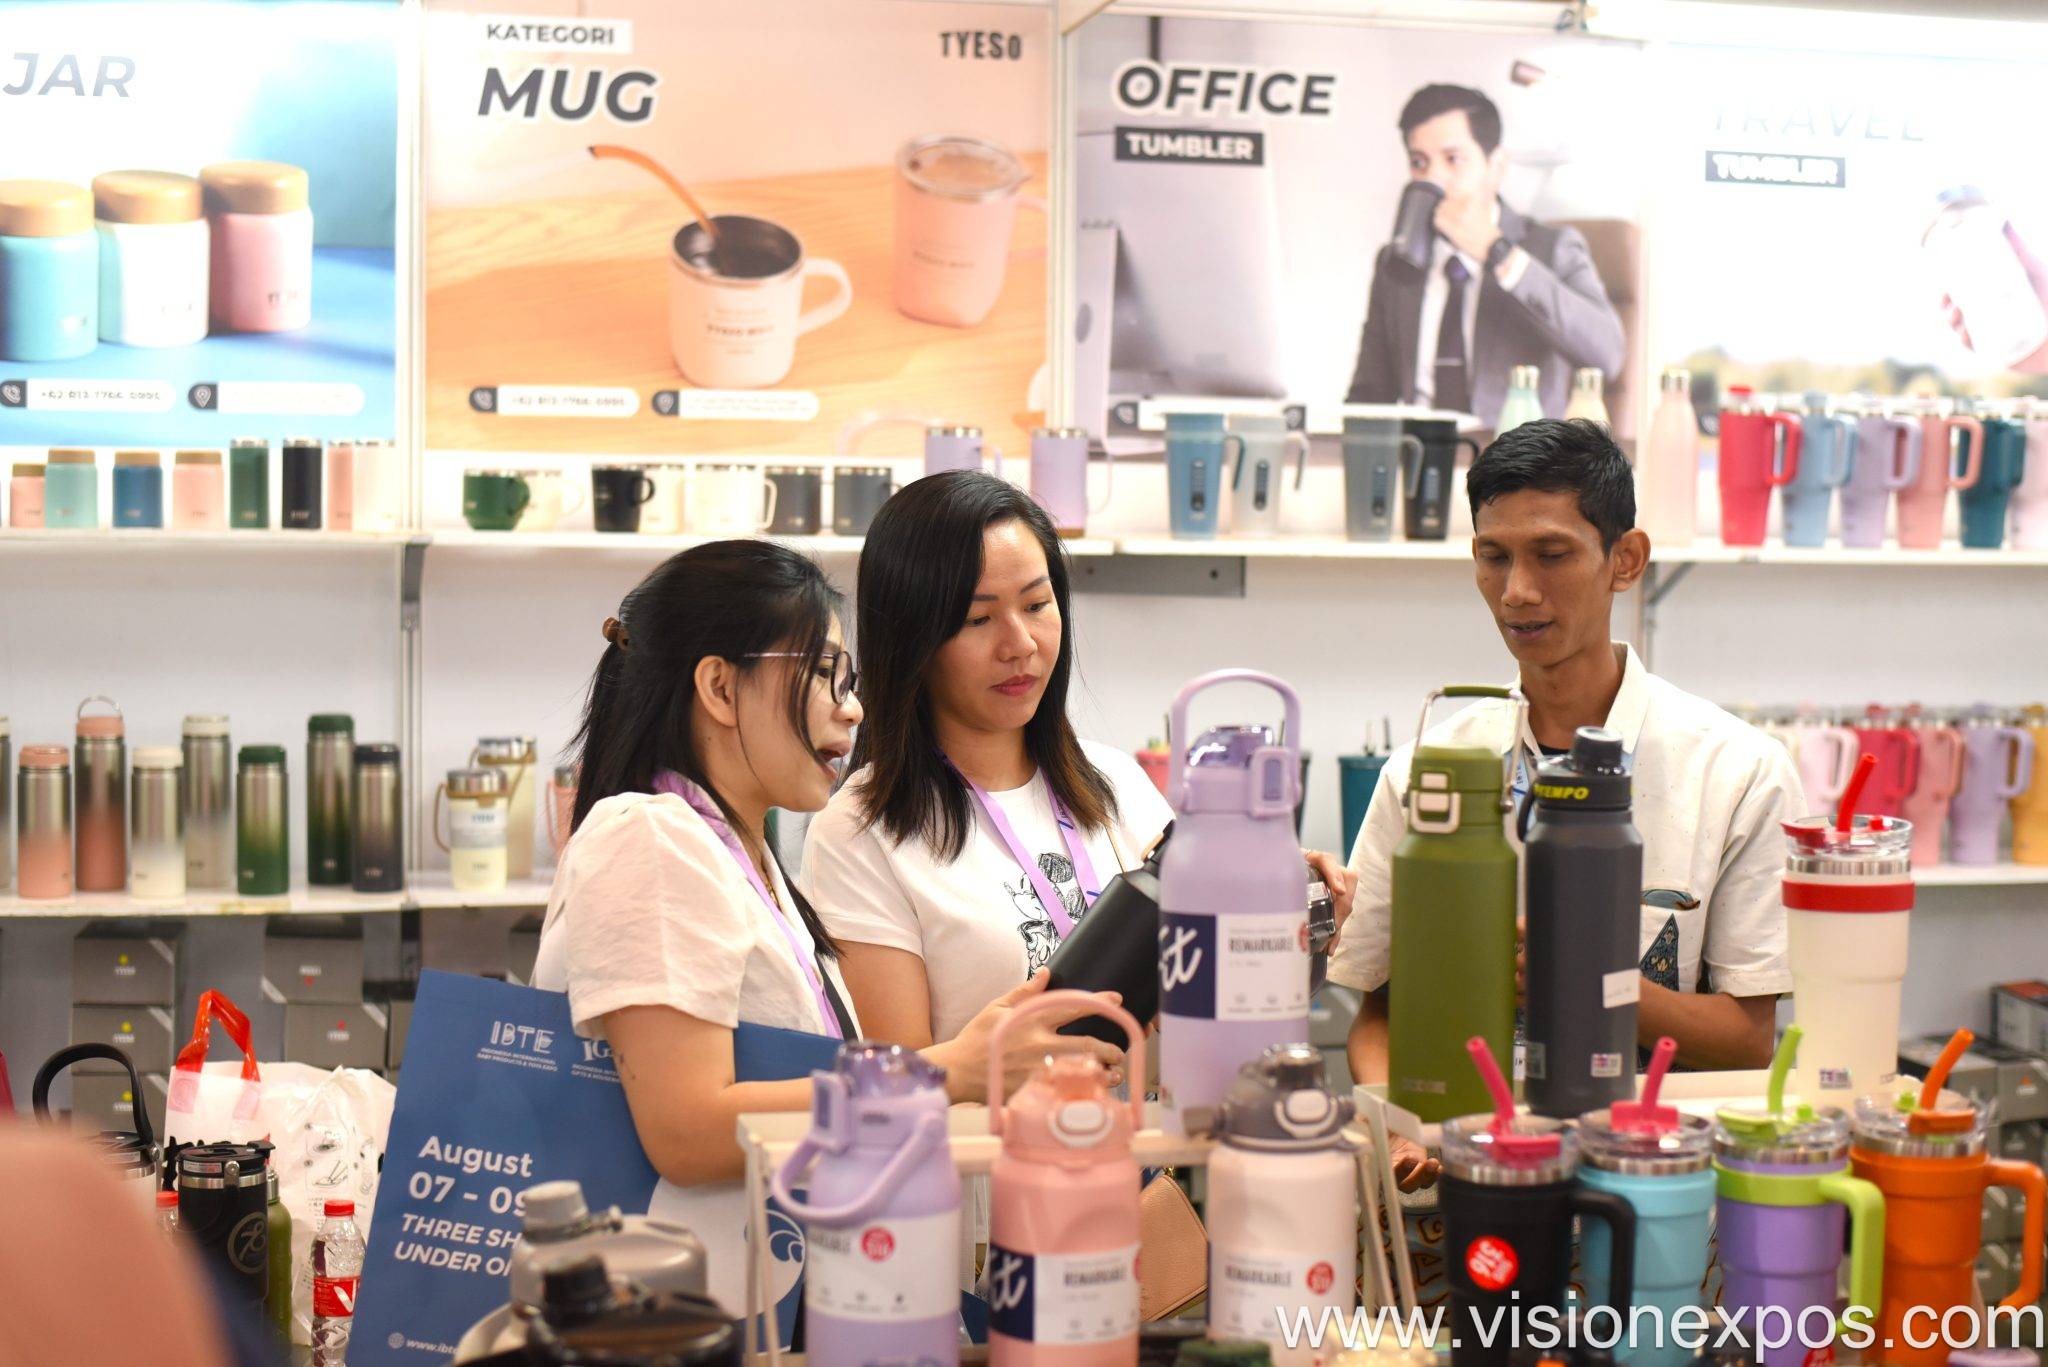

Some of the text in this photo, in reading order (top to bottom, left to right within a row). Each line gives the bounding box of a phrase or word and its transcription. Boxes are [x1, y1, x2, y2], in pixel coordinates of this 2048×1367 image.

[486, 23, 615, 45] KATEGORI
[940, 31, 1022, 60] TYESO
[2, 52, 136, 98] JAR
[1118, 66, 1335, 115] OFFICE
[477, 67, 657, 122] MUG
[1710, 101, 1926, 142] TRAVEL
[1125, 132, 1255, 160] TUMBLER
[490, 1020, 555, 1054] IBTE
[418, 1135, 533, 1178] August
[409, 1171, 456, 1203] 07
[463, 1191, 478, 1201] -
[401, 1212, 484, 1245] THREE
[394, 1241, 482, 1273] UNDER
